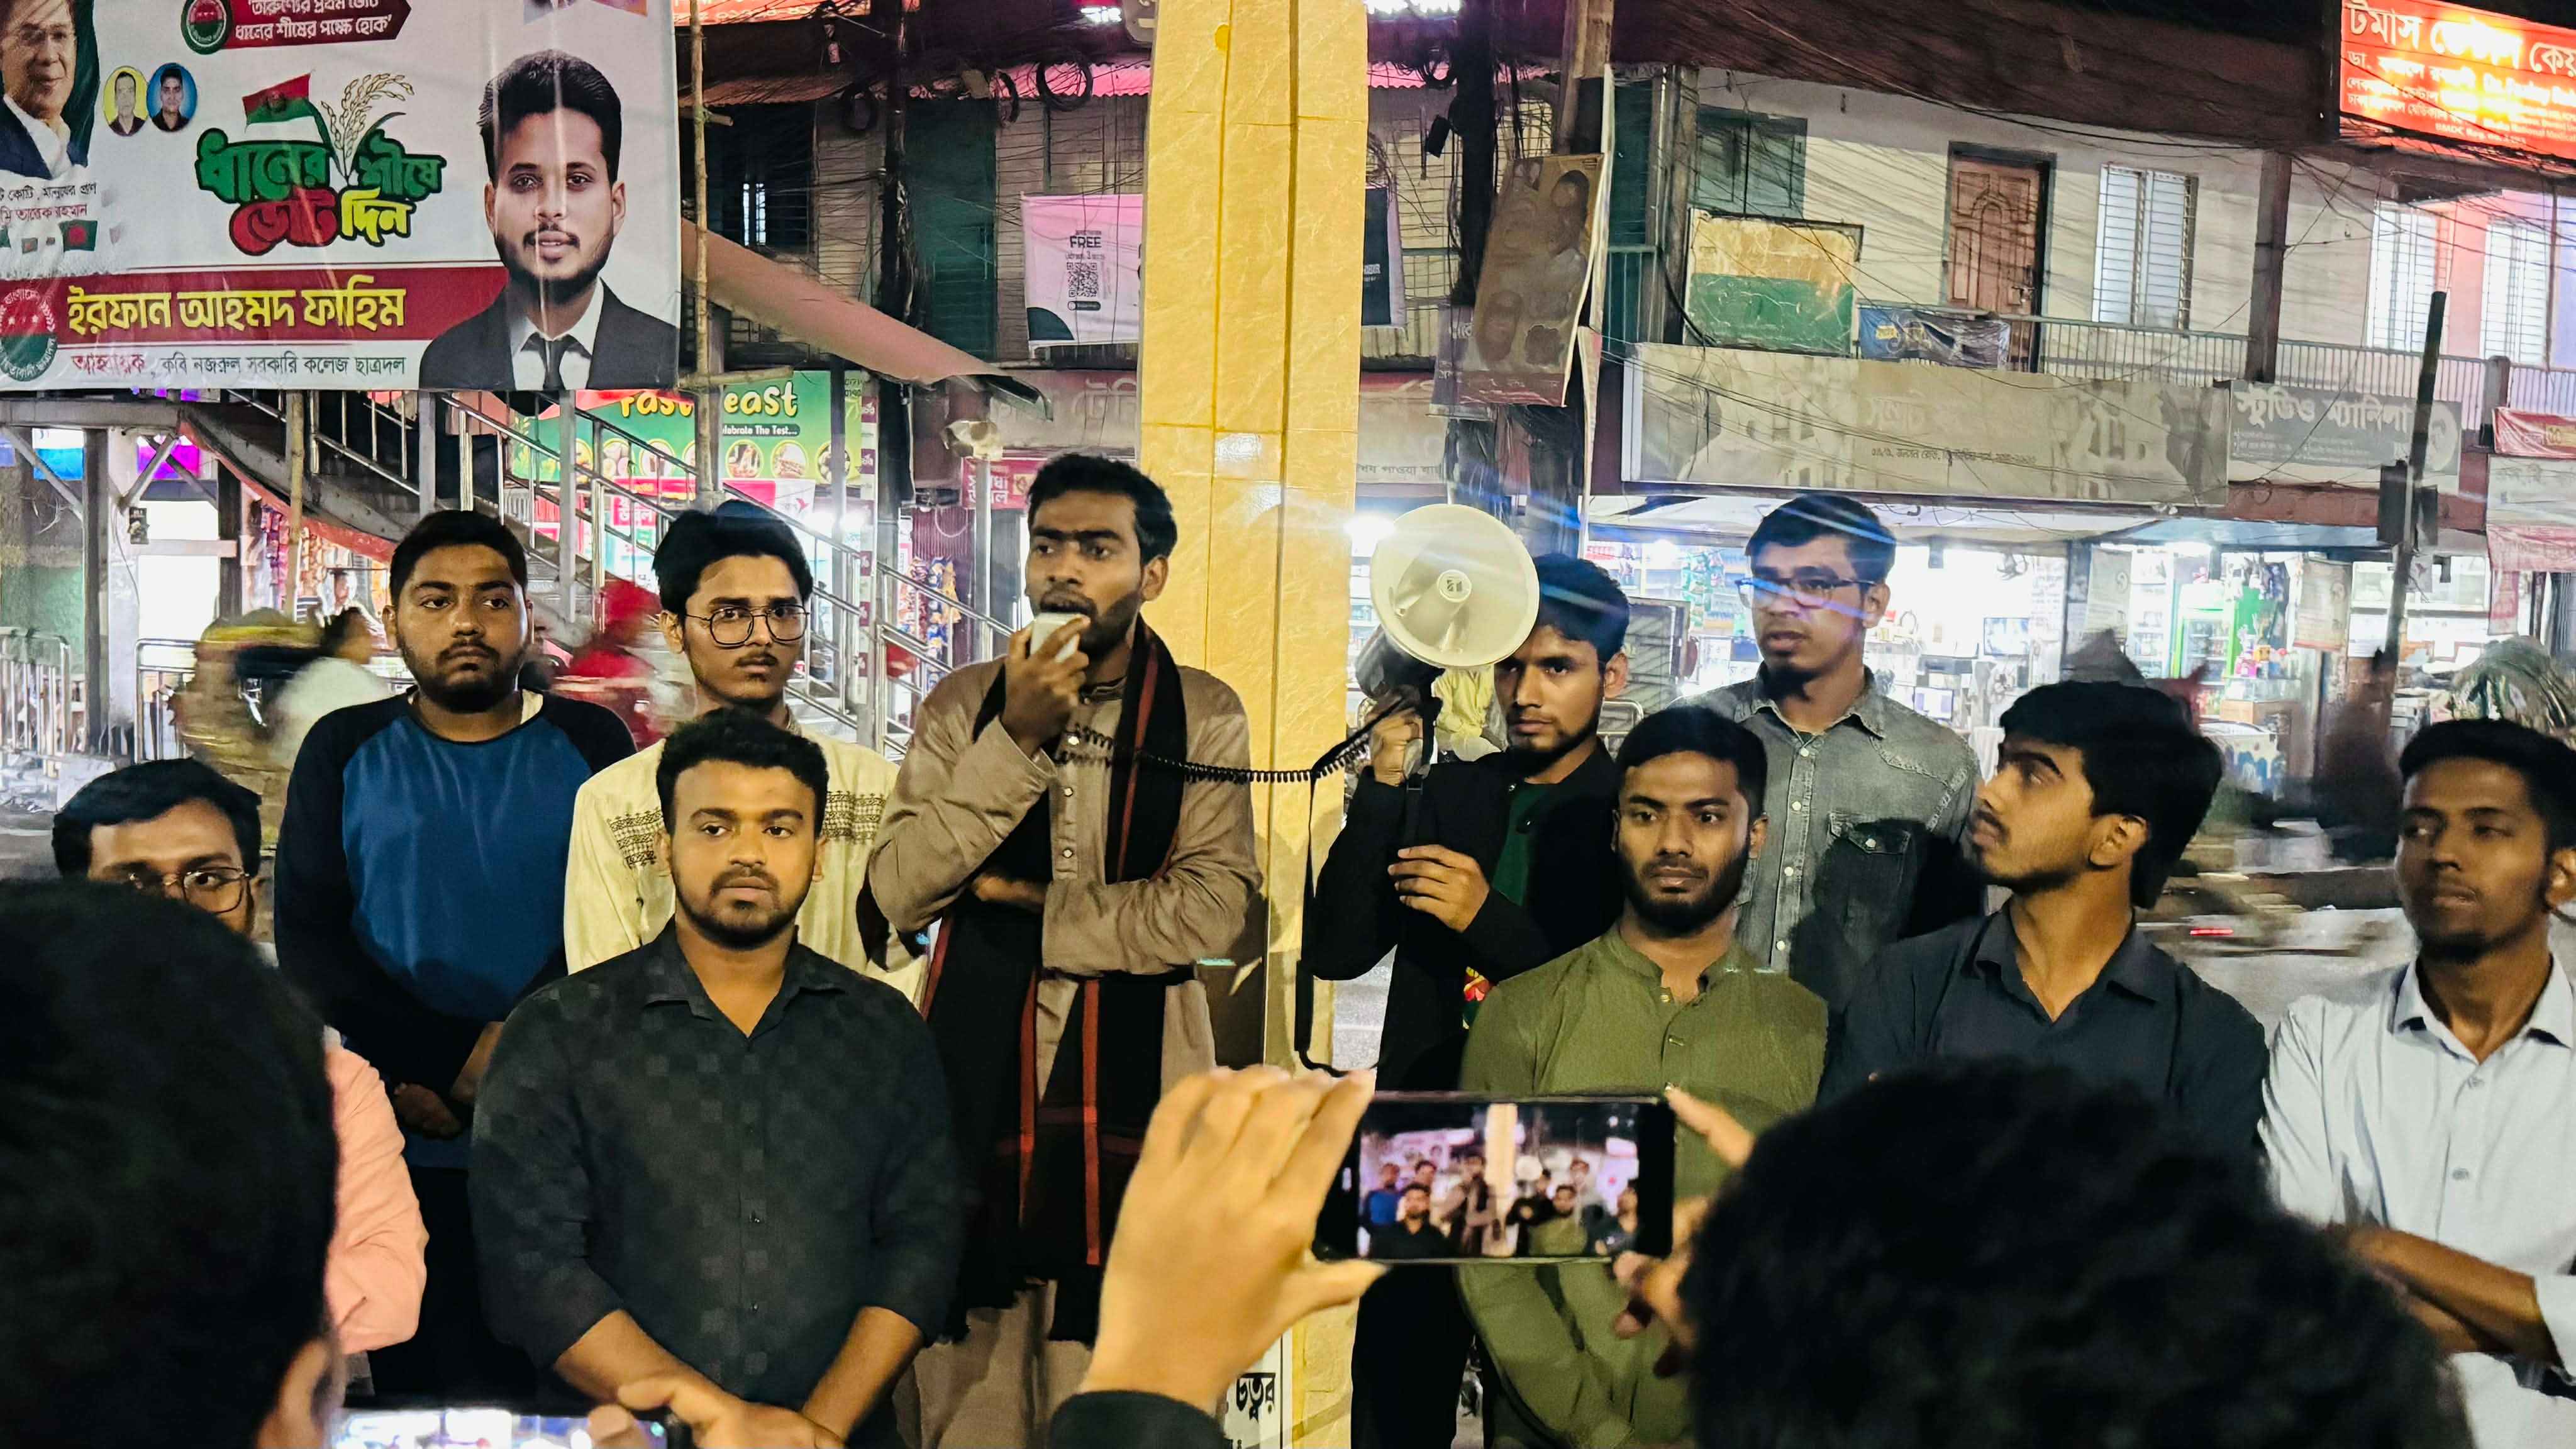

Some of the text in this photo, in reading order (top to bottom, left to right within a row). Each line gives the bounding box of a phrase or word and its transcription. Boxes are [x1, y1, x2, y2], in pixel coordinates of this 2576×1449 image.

[235, 23, 274, 40] ধানের
[276, 14, 317, 39] শীষের
[320, 18, 354, 36] পক্ষে
[2529, 42, 2576, 77] কেয়
[338, 186, 416, 247] দিন
[1069, 236, 1102, 248] FREE
[67, 274, 406, 335] ইরফান আহমদ ফাহিম
[162, 350, 187, 375] কবি
[193, 356, 241, 375] নজরুল
[303, 356, 350, 375] কলেজ
[354, 355, 406, 375] ছাত্রদল
[723, 380, 799, 417] east
[755, 425, 770, 436] The
